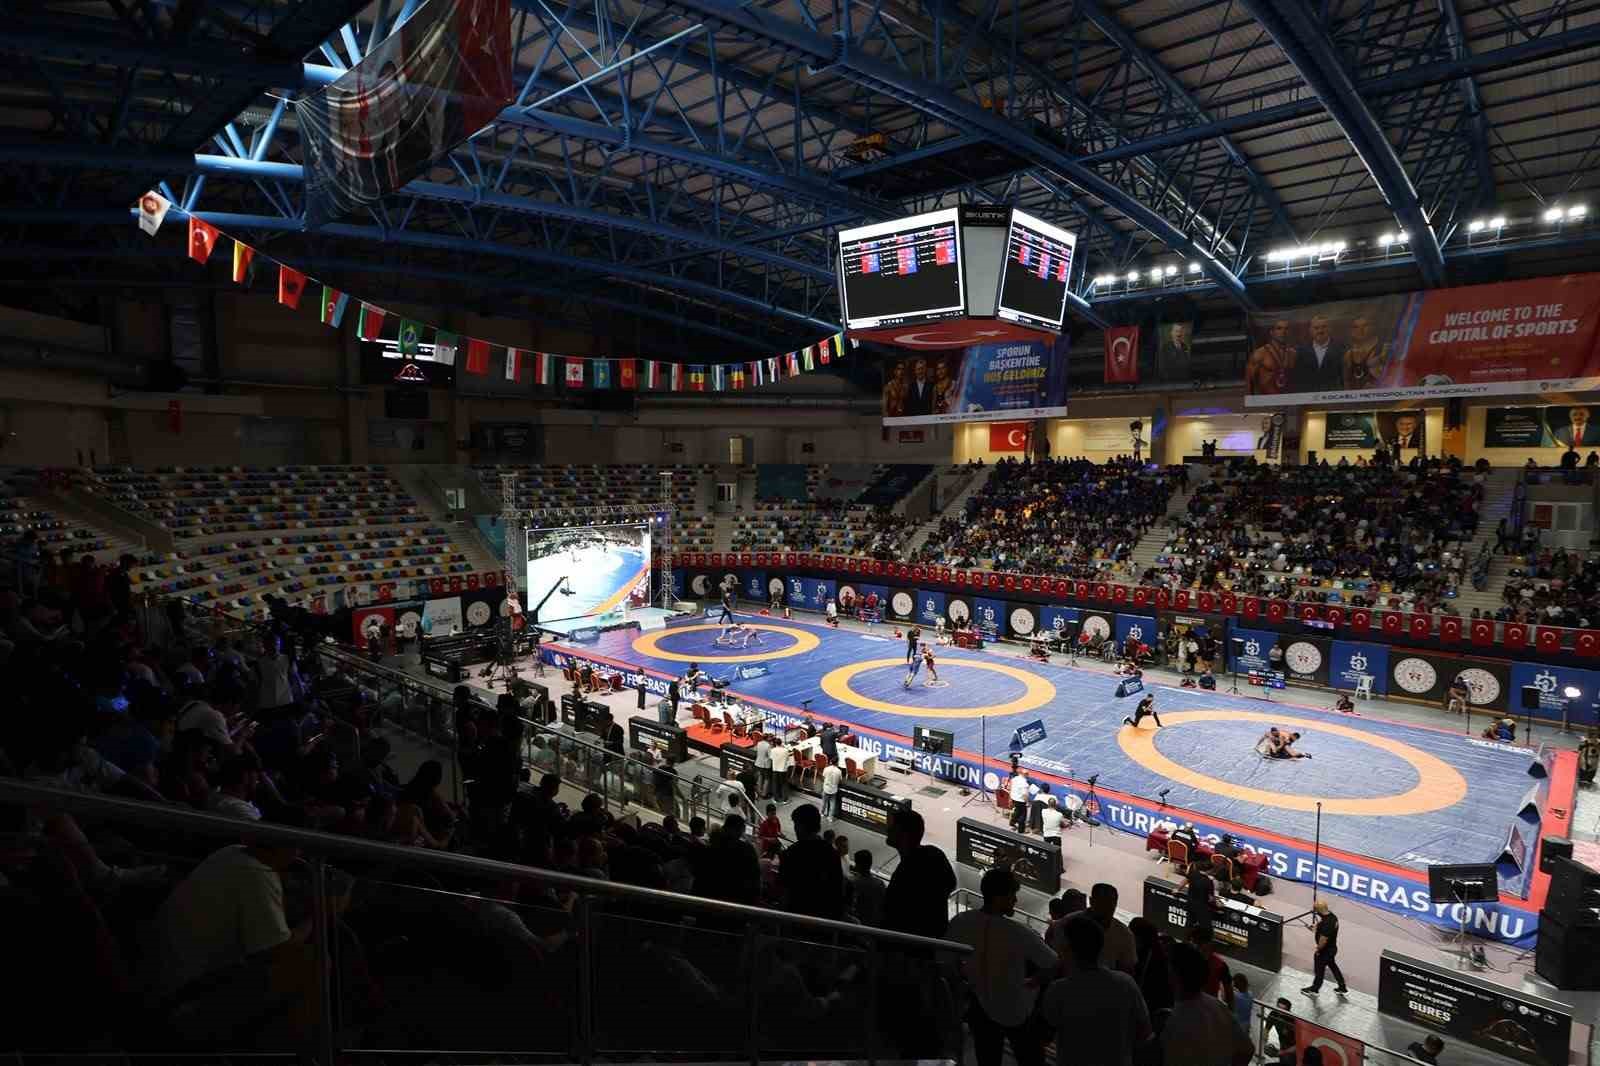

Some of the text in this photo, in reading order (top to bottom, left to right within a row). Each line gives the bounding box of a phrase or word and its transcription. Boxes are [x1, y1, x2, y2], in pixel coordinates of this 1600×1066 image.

[1445, 303, 1563, 327] WELCOME TO THE
[1429, 319, 1579, 344] CAPITAL OF SPORTS
[997, 344, 1031, 358] SPORUN
[886, 743, 981, 785] FEDERATION
[1107, 804, 1200, 841] TÜRKE
[1296, 857, 1524, 939] FEDERASYONU
